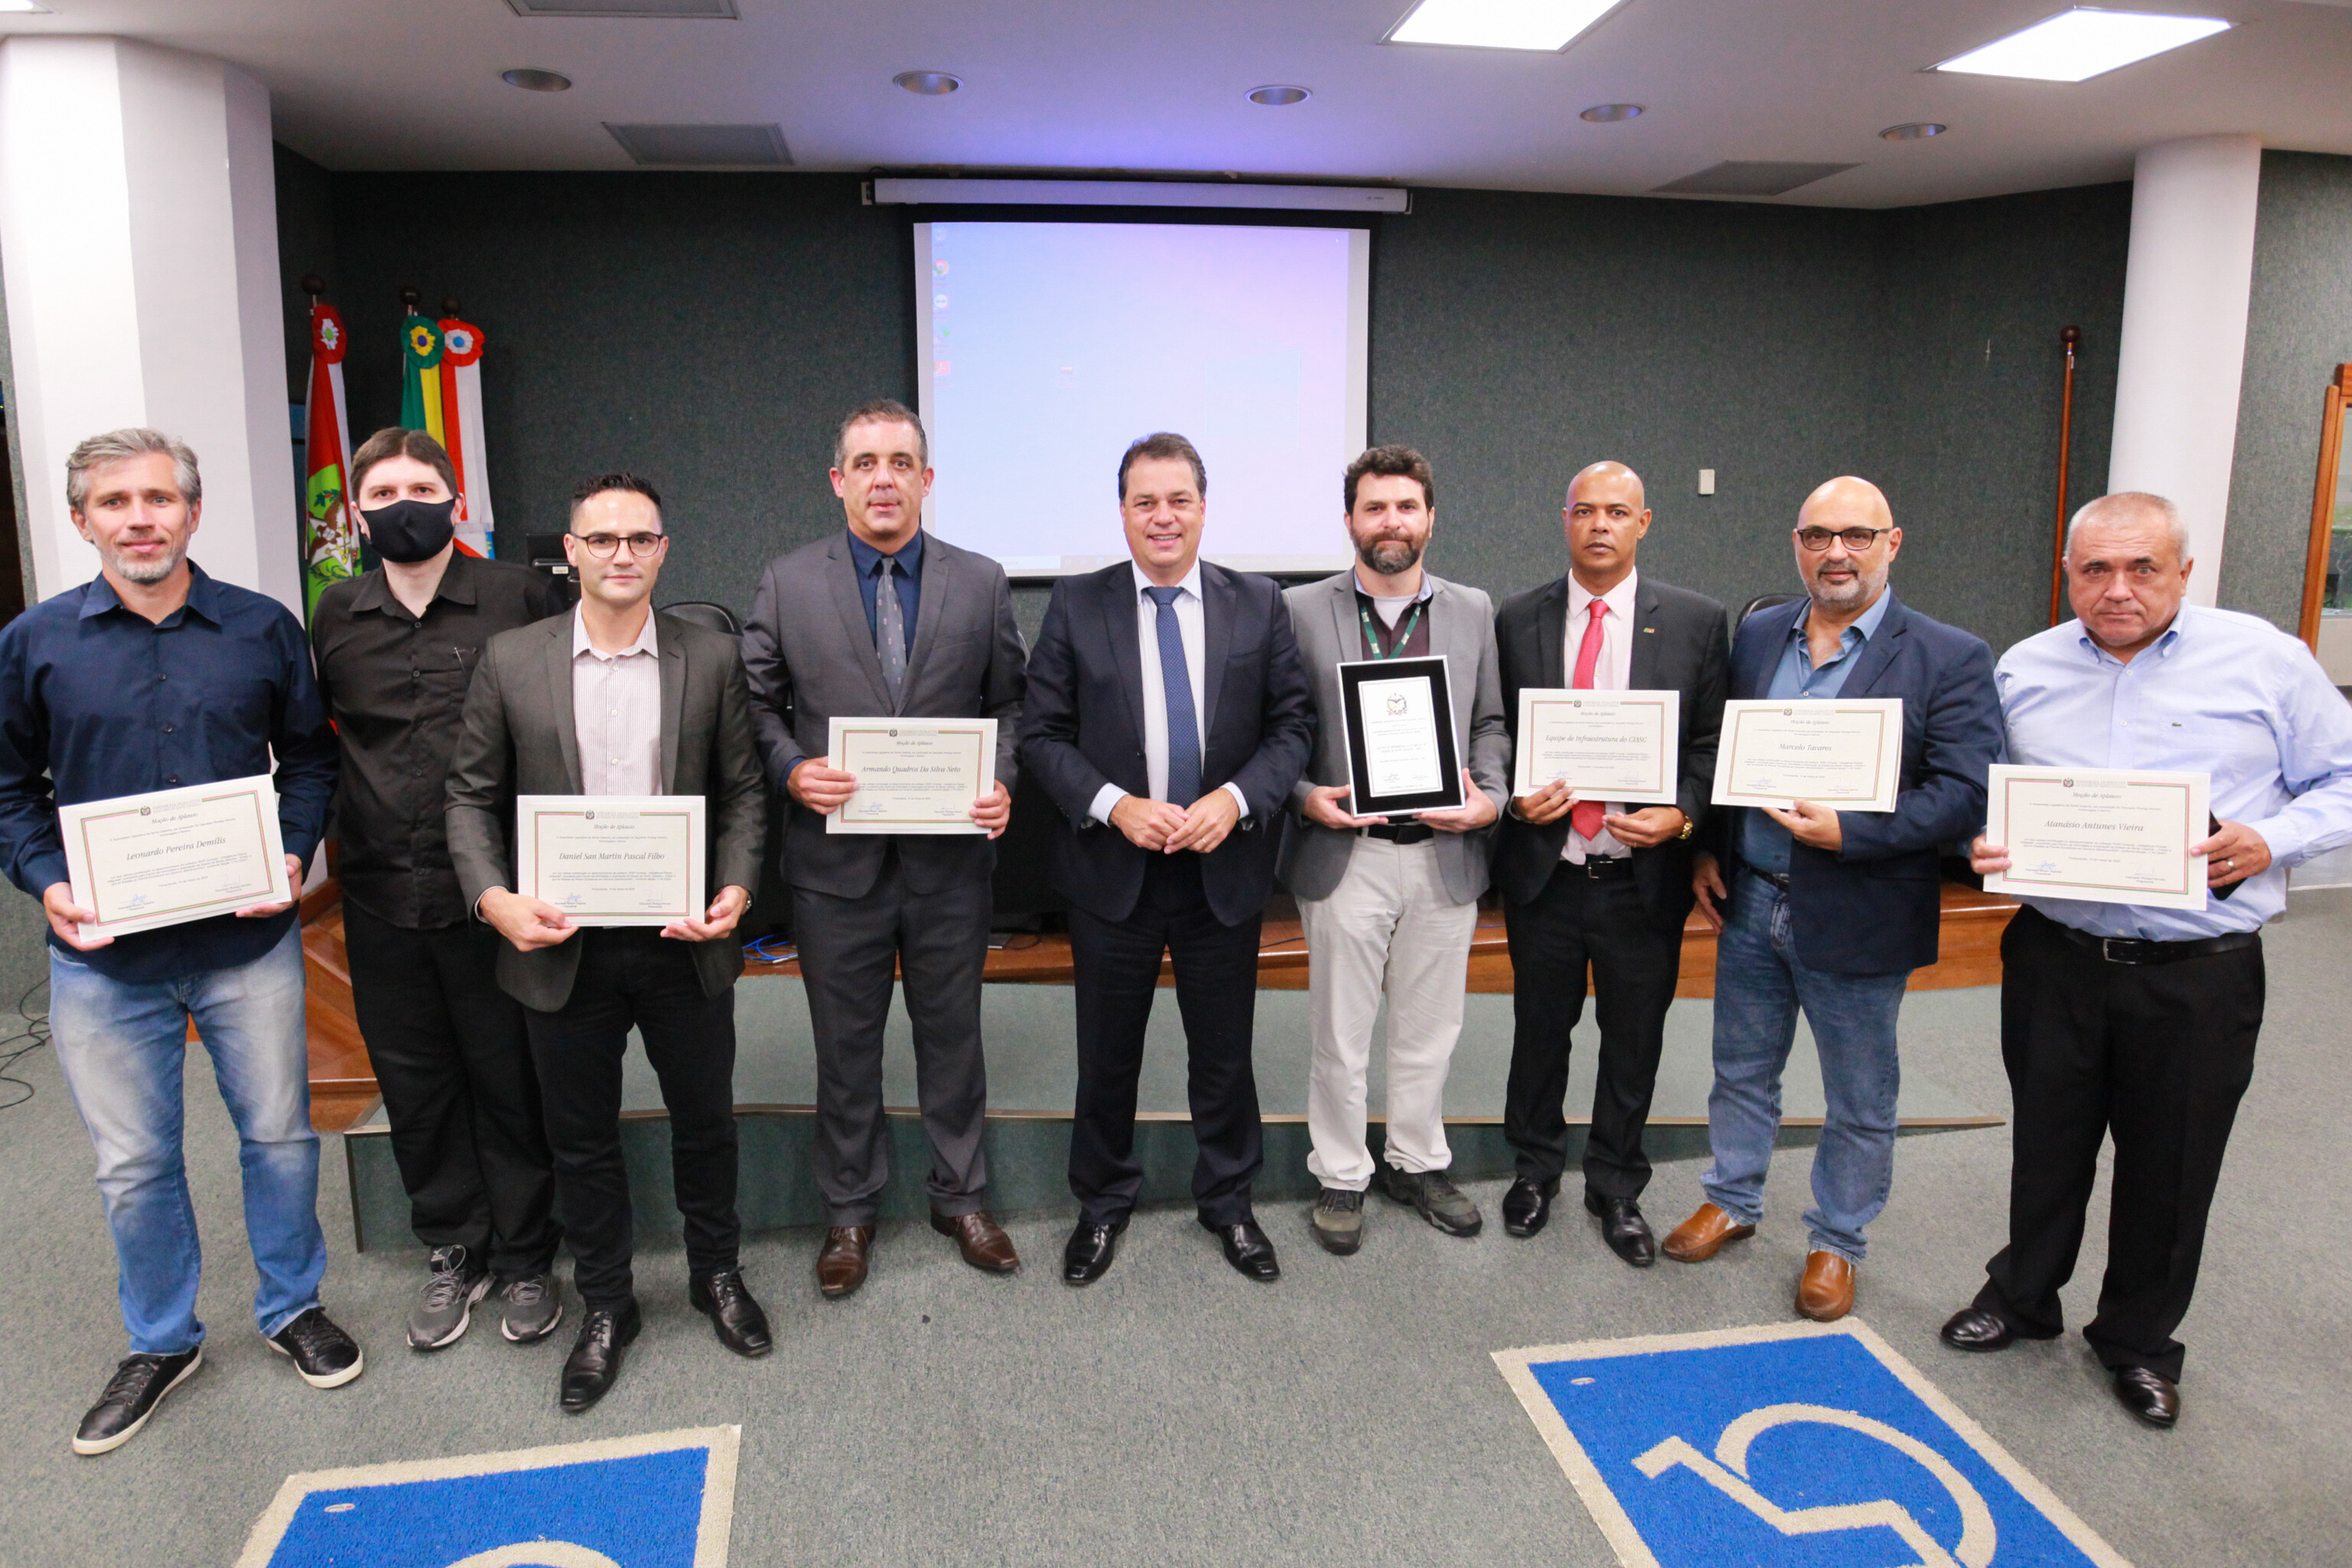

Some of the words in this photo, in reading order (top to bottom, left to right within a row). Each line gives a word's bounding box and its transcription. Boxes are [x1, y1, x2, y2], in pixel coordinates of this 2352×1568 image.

[893, 766, 919, 774] Quadros
[2043, 820, 2080, 829] Atanásio
[2081, 822, 2116, 831] Antunes
[2118, 823, 2144, 832] Vieira
[126, 847, 164, 861] Leonardo
[165, 842, 194, 855] Pereira
[196, 836, 227, 850] Demílis
[559, 851, 583, 861] Daniel
[624, 851, 646, 861] Pascal
[647, 851, 665, 860] Filho
